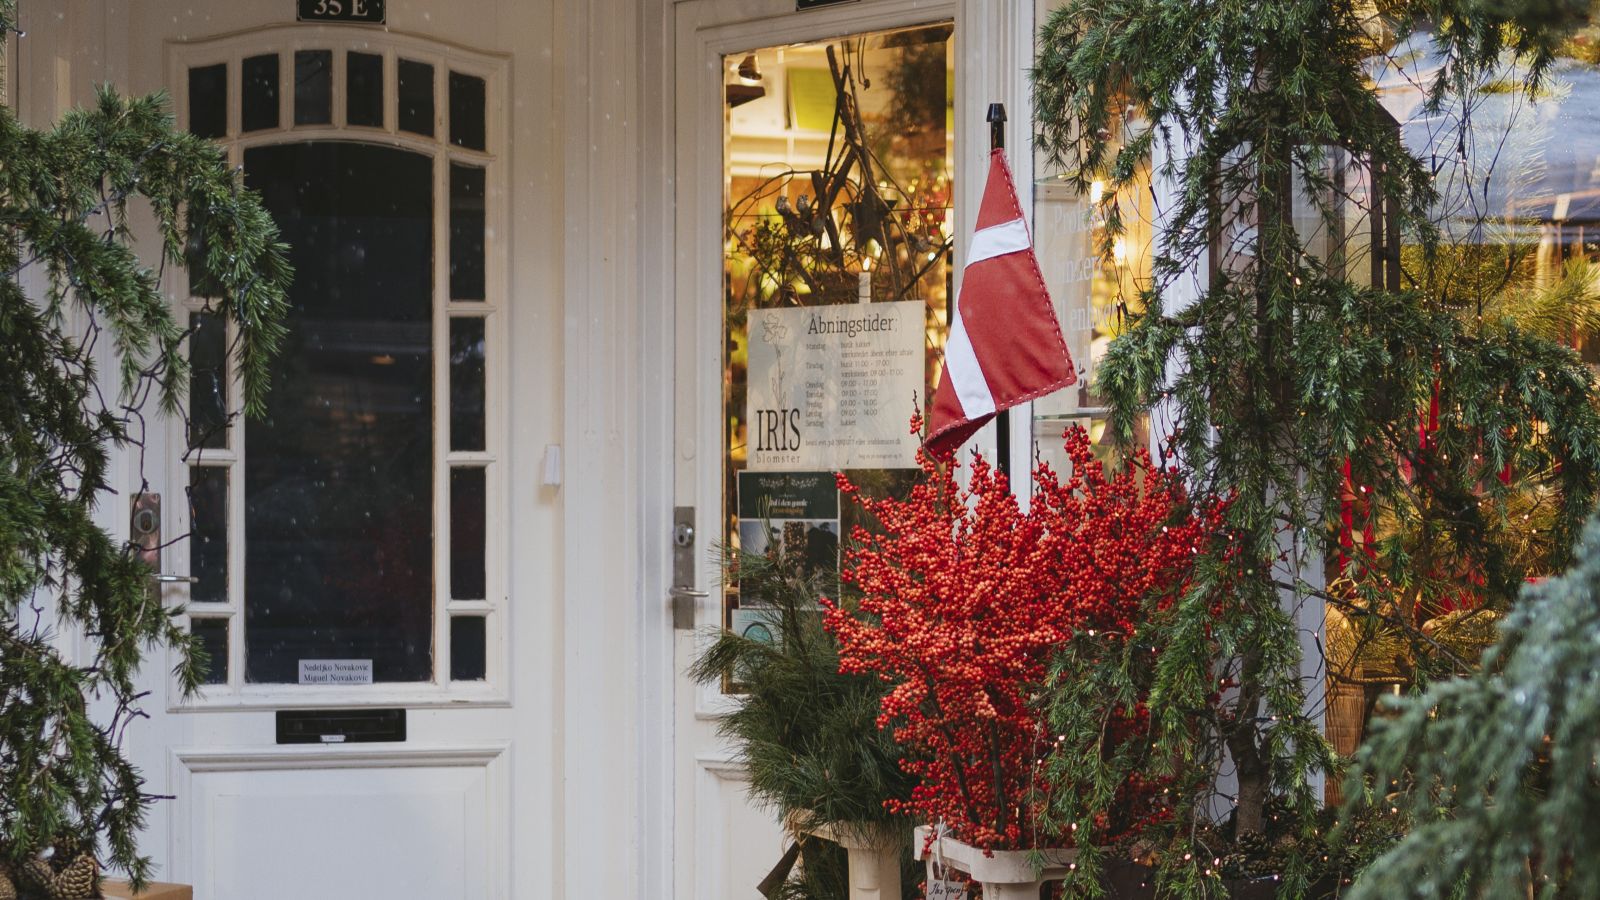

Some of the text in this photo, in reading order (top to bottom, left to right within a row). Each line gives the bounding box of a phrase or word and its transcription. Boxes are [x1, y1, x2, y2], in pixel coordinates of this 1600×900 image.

[314, 0, 368, 16] 35 E
[756, 408, 801, 451] IRIS
[756, 453, 801, 464] blomster
[304, 674, 328, 683] Miguel
